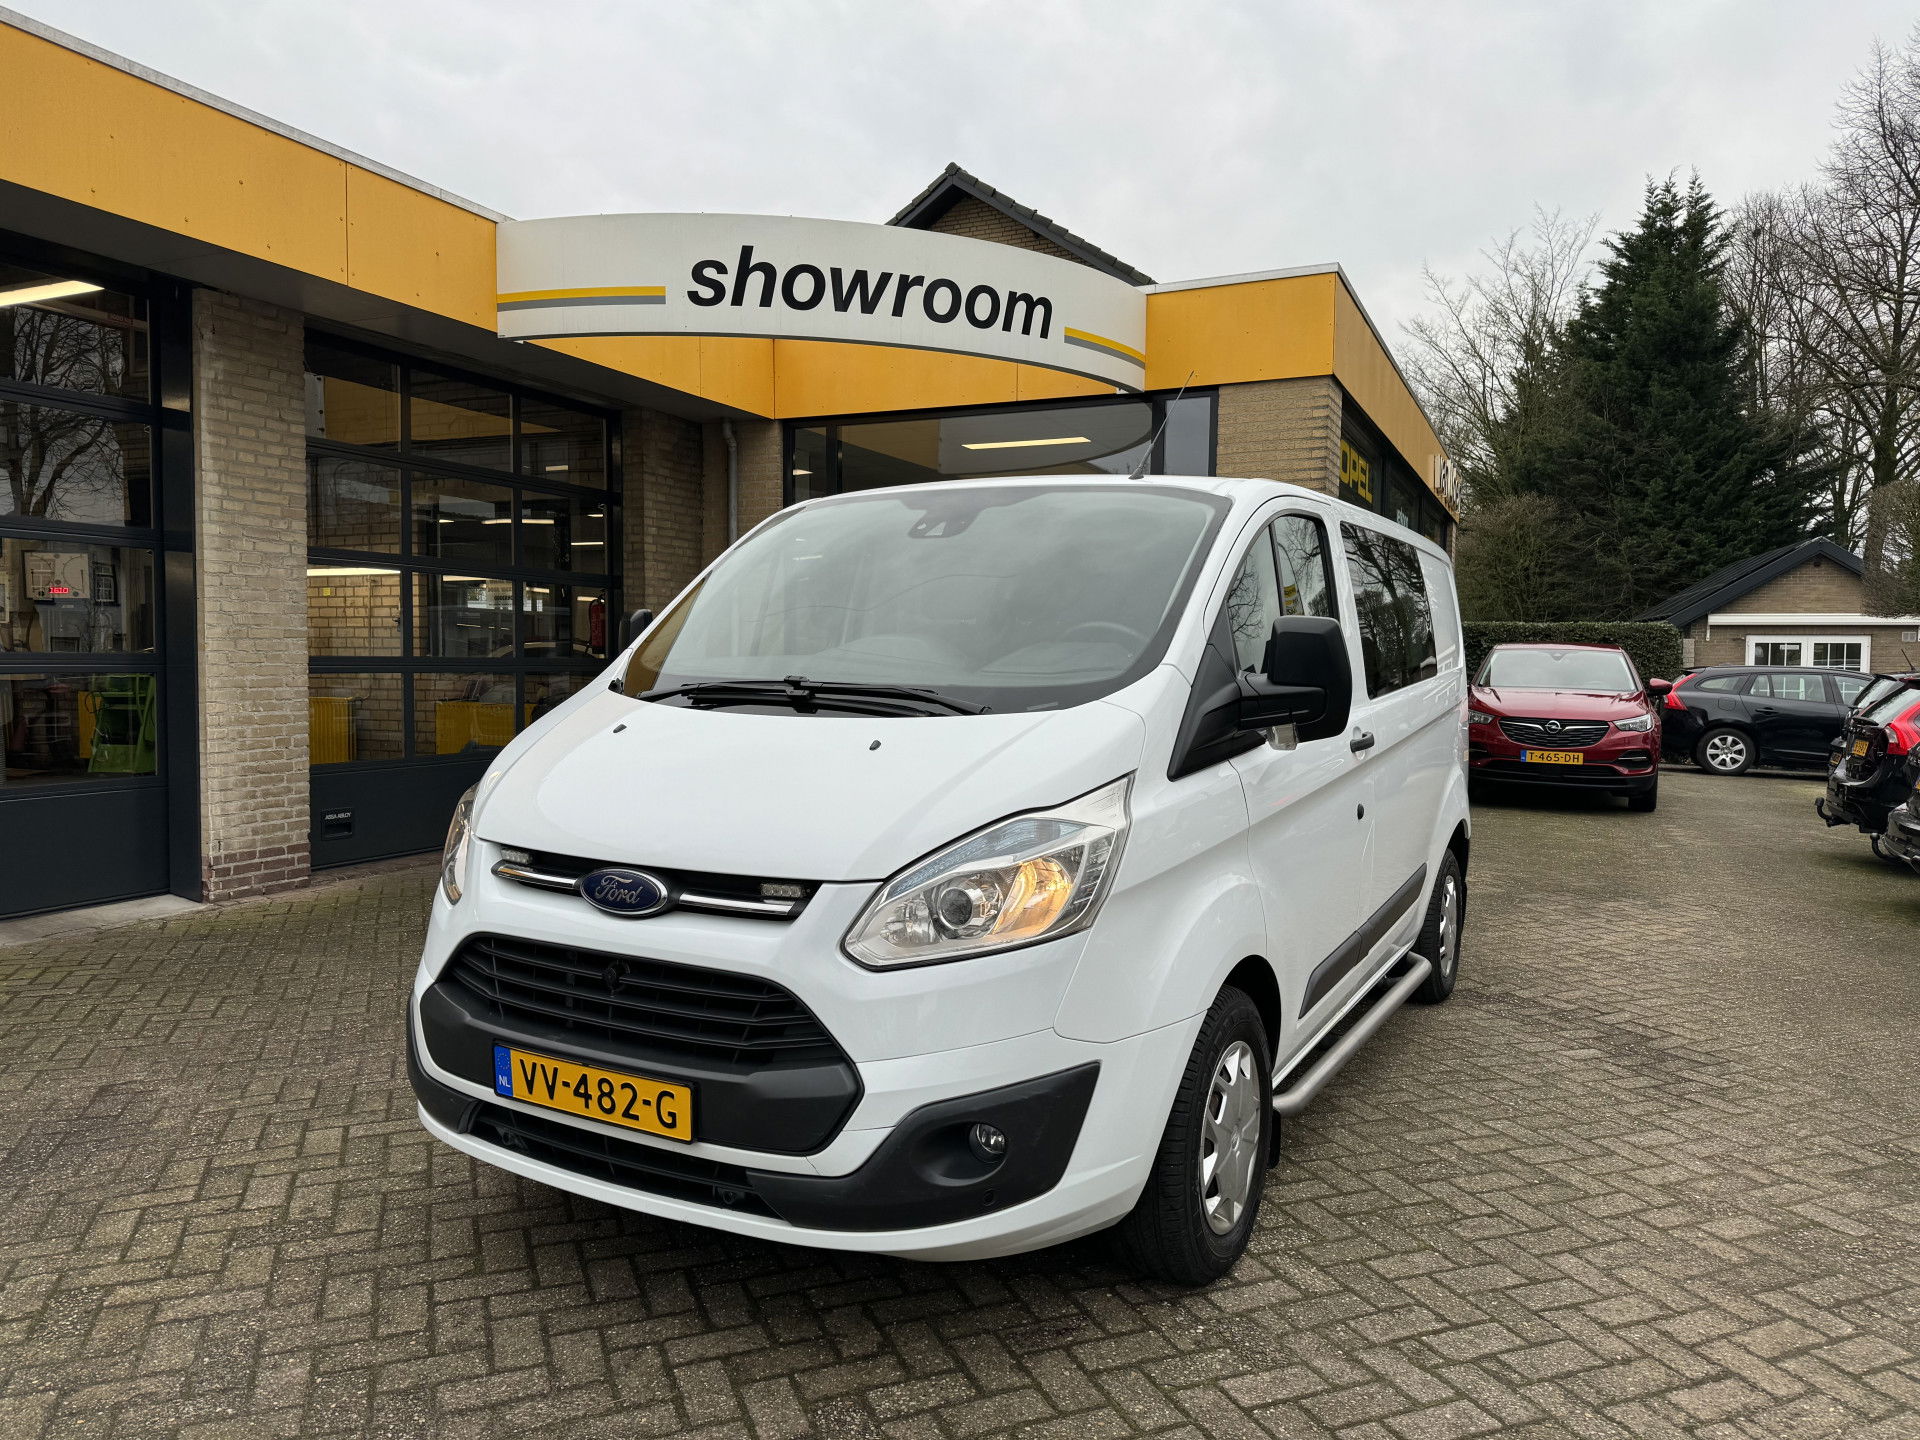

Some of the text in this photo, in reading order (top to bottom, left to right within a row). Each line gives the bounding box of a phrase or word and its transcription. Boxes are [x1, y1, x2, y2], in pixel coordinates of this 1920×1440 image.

[687, 245, 1053, 339] showroom
[1340, 439, 1373, 504] OPEL
[1528, 751, 1580, 763] T-465-DH
[595, 875, 644, 904] Ford
[499, 1074, 511, 1088] NL
[519, 1058, 678, 1129] VV-482-G
